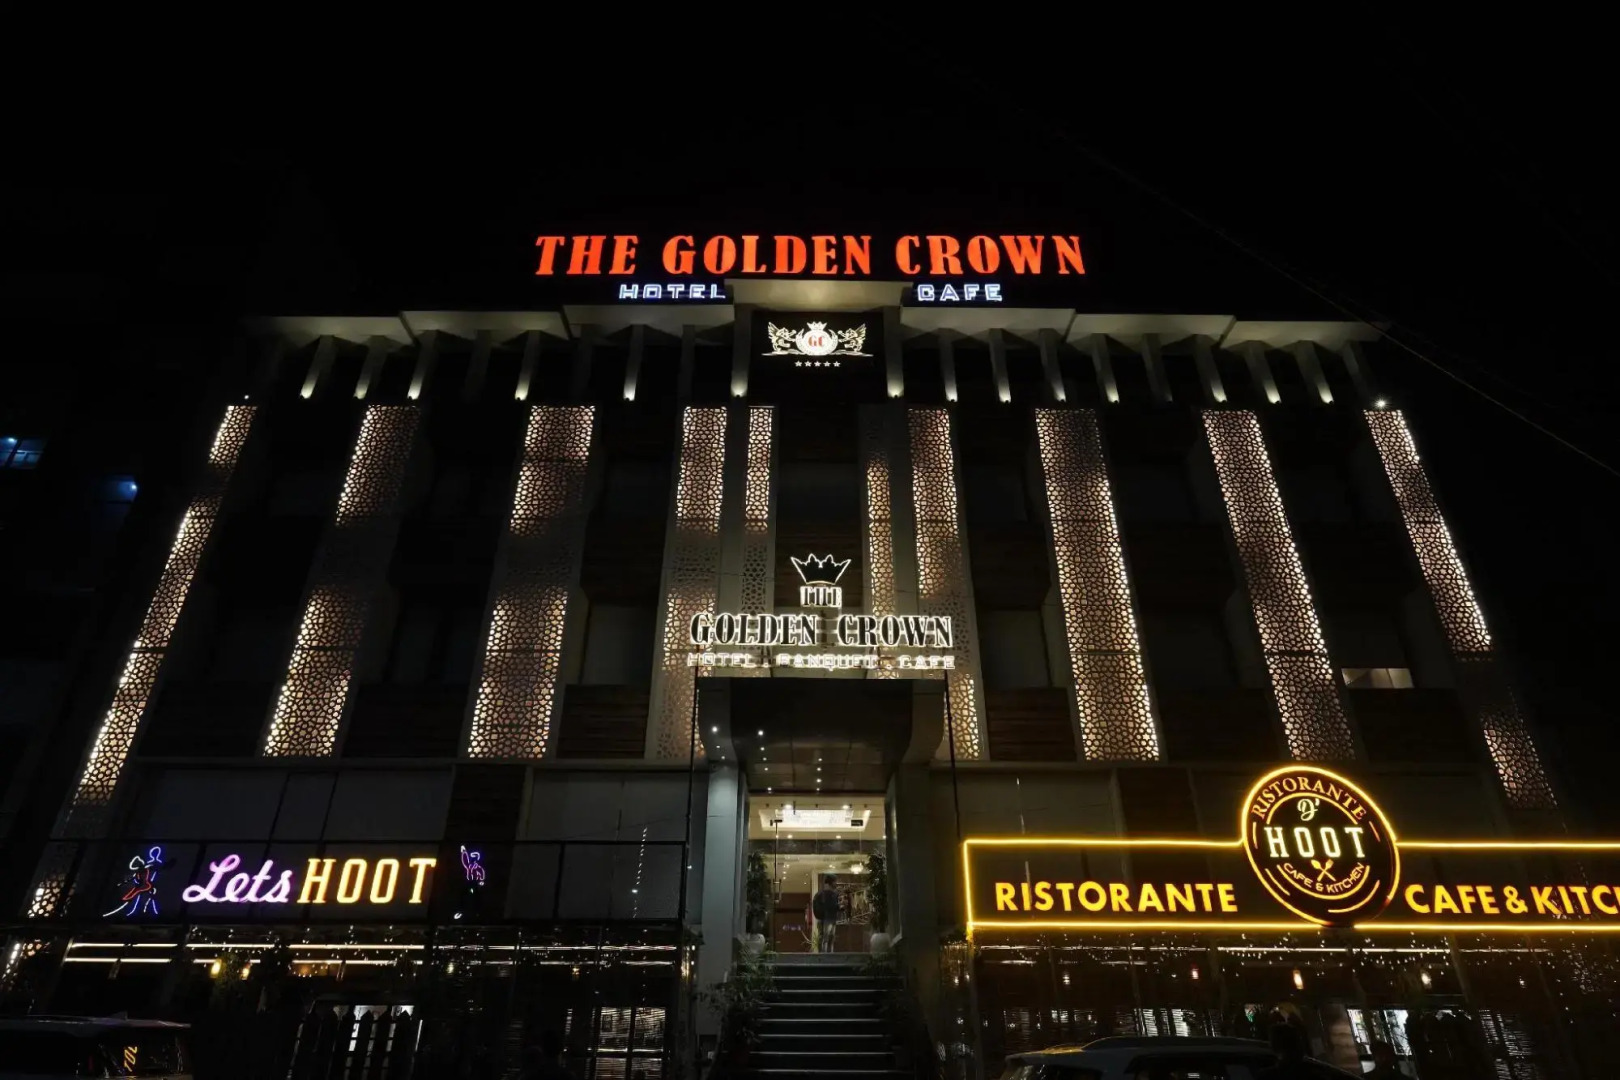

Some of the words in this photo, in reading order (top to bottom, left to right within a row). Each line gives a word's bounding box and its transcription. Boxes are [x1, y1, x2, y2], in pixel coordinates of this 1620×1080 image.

[535, 235, 639, 275] THE
[662, 235, 872, 275] GOLDEN
[895, 235, 1086, 275] CROWN
[618, 283, 726, 299] HOTEL
[917, 283, 1003, 301] CAFE
[800, 586, 842, 609] THE
[690, 612, 818, 646] GOLDEN
[837, 613, 954, 647] CROWN
[898, 654, 956, 670] CAFE
[1251, 776, 1367, 820] RISTORANTE
[1263, 826, 1366, 858] HOOT
[182, 854, 293, 903] Lets
[297, 858, 437, 903] HOOT
[1283, 862, 1313, 889] CAFE
[1315, 882, 1324, 892] &
[1326, 861, 1365, 894] KITCHEN
[995, 881, 1238, 912] RISTORANTE
[1530, 884, 1620, 914] KITC
